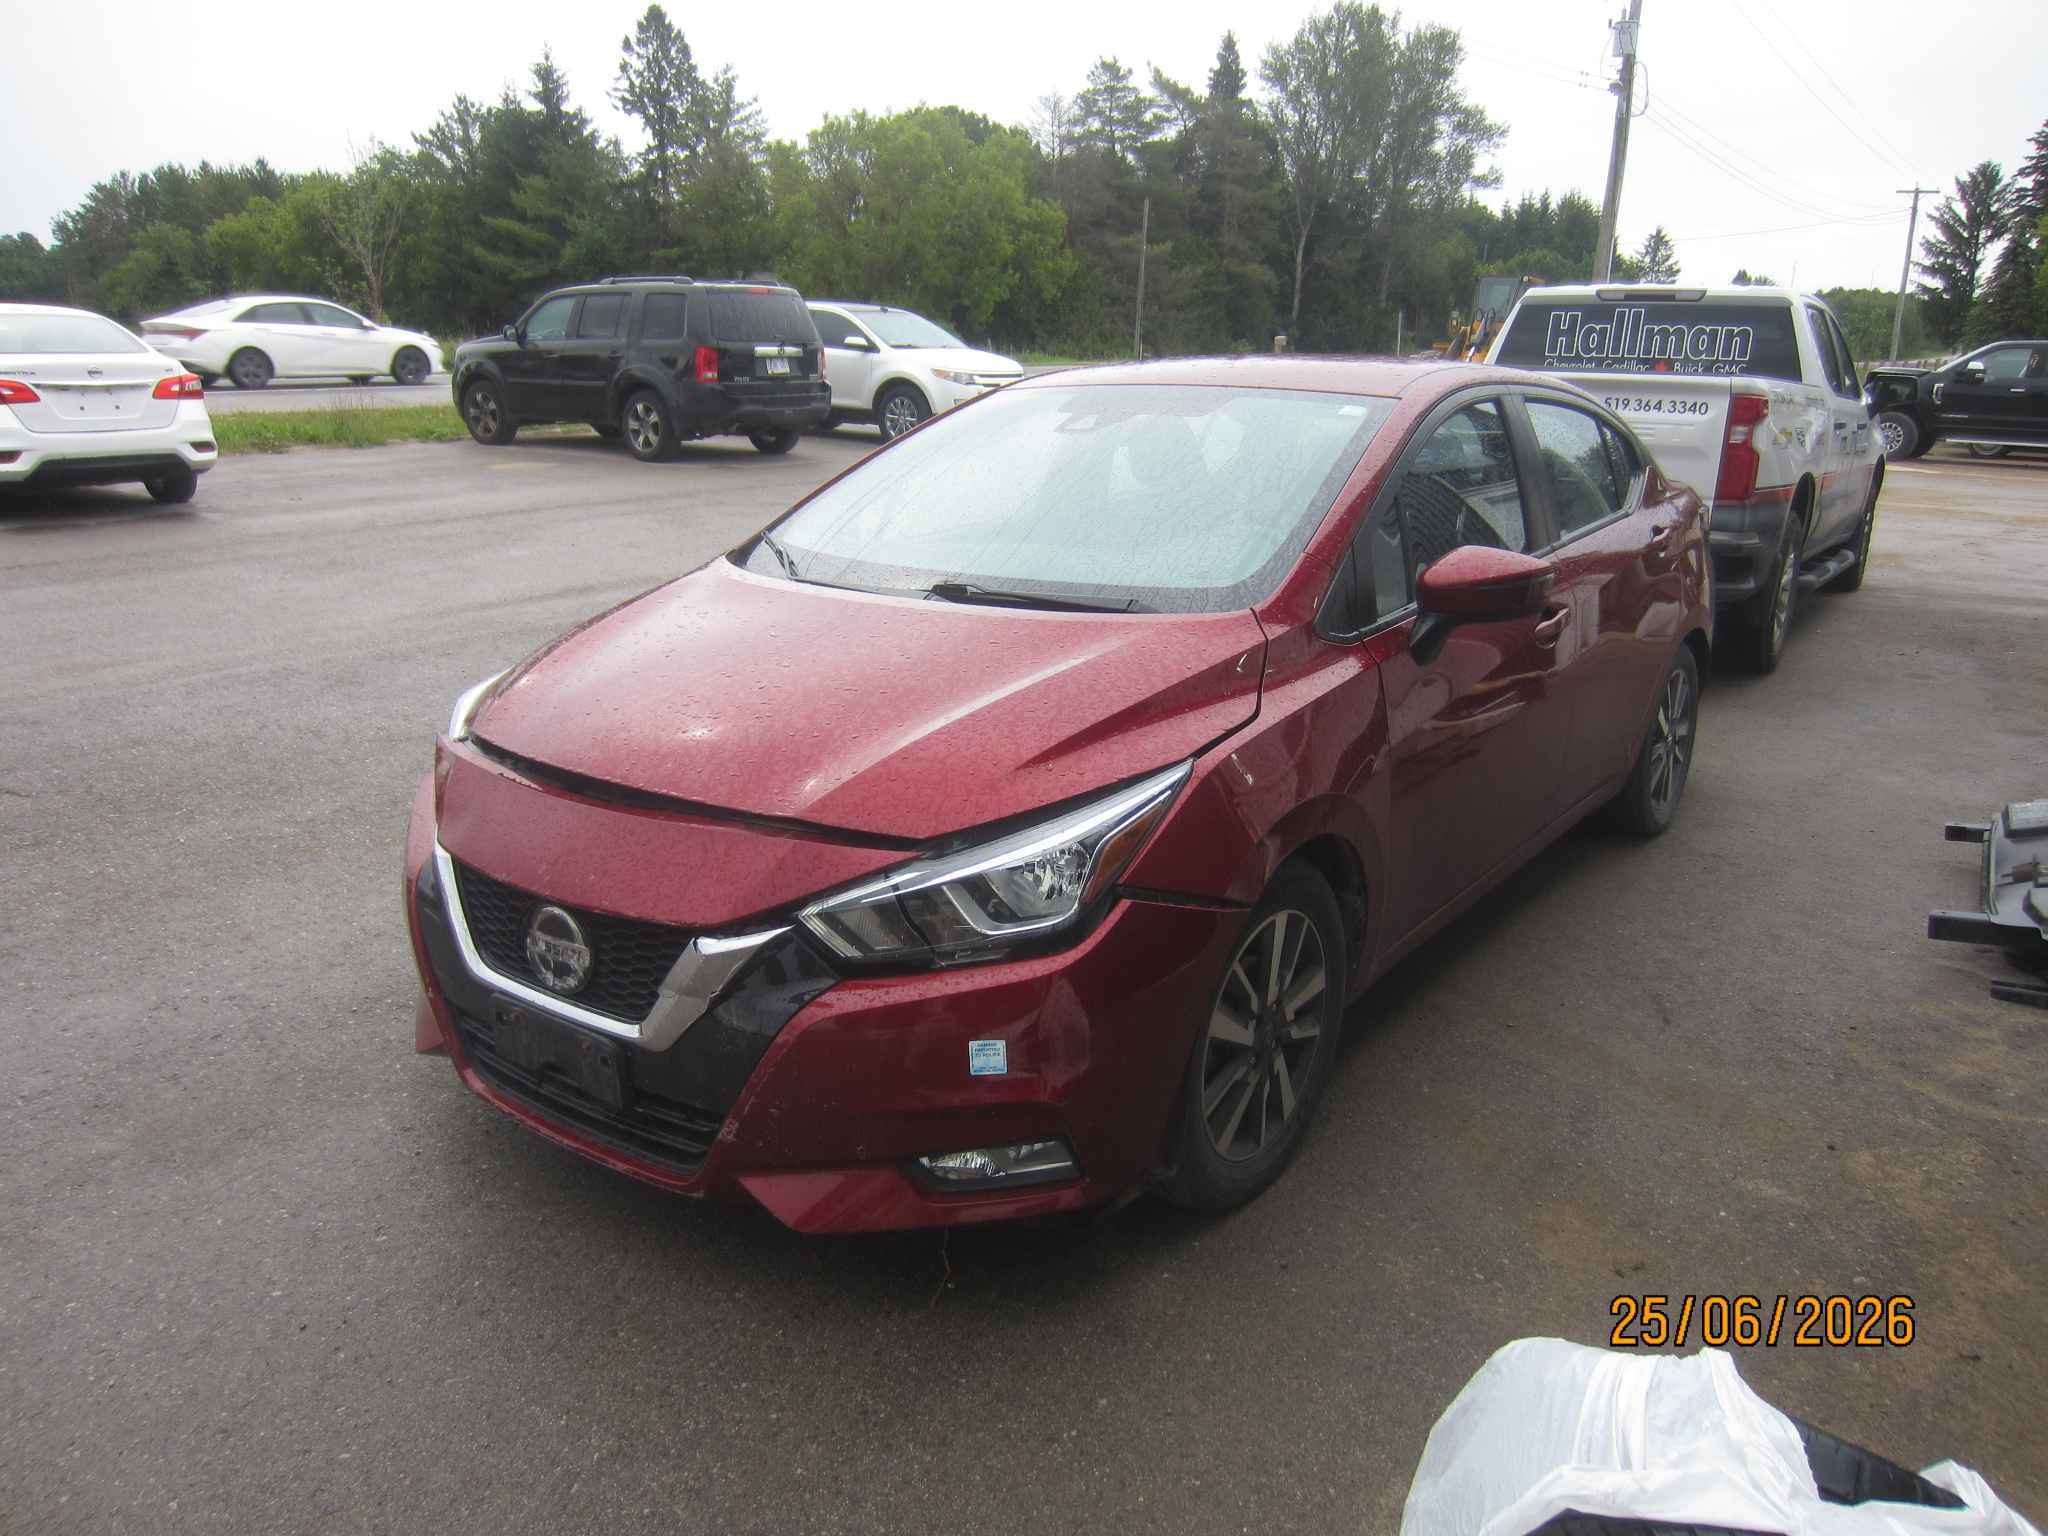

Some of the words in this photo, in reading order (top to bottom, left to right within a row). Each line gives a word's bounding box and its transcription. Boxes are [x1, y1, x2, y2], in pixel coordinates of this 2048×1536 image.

[1545, 308, 1753, 361] Hallman
[1602, 360, 1650, 372] Cadillac
[1673, 362, 1704, 374] Buick
[1712, 363, 1748, 375] GMC
[1604, 397, 1709, 416] 519.364.3340
